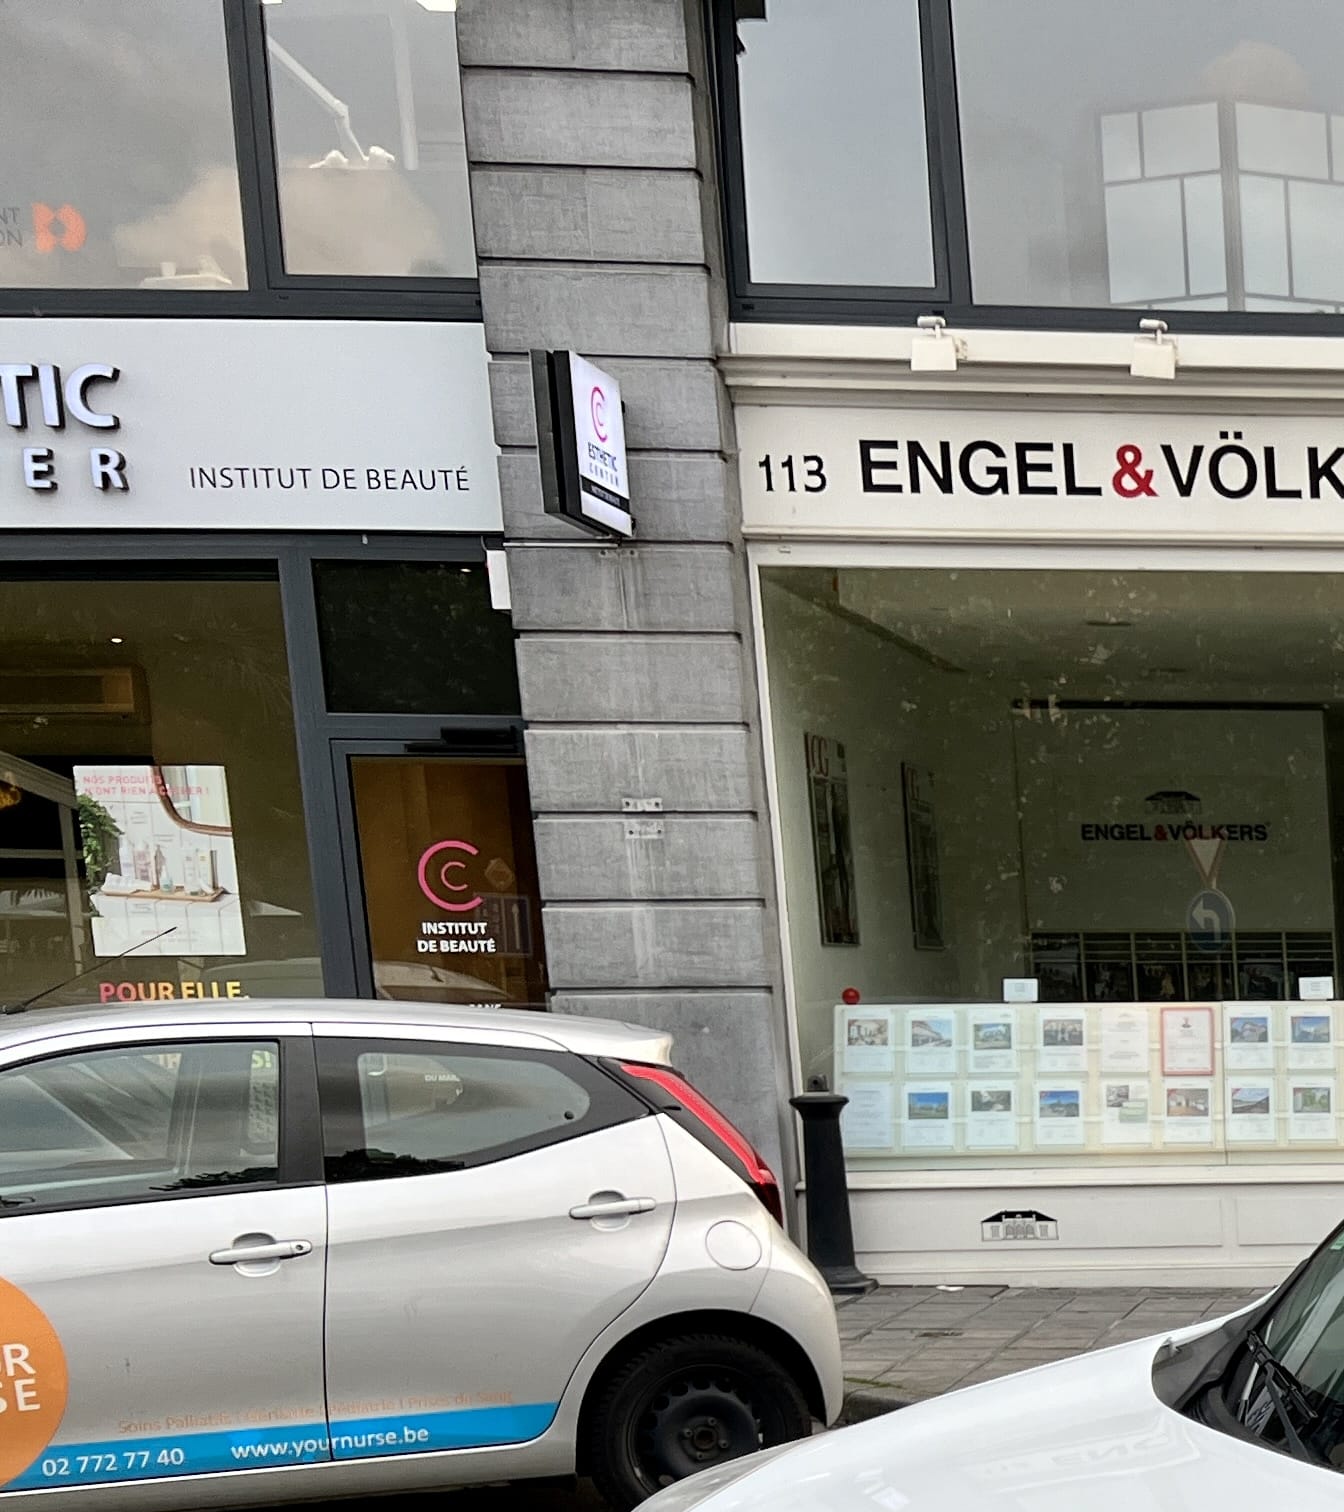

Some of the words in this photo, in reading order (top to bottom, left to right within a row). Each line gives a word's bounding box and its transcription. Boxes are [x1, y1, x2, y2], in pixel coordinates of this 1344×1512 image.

[189, 466, 312, 489] INSTITUT
[321, 468, 358, 489] DE
[366, 465, 470, 491] BEAUTÉ
[758, 454, 827, 492] 113
[421, 921, 488, 935] INSTITUT
[416, 939, 437, 953] DE
[439, 937, 497, 953] BEAUTÉ
[98, 981, 175, 1003] POUR
[0, 1342, 37, 1378] R
[41, 1457, 71, 1477] 02
[76, 1452, 118, 1475] 772
[122, 1450, 151, 1471] 77
[157, 1447, 185, 1466] 40
[231, 1425, 430, 1460] www.yournurse.be
